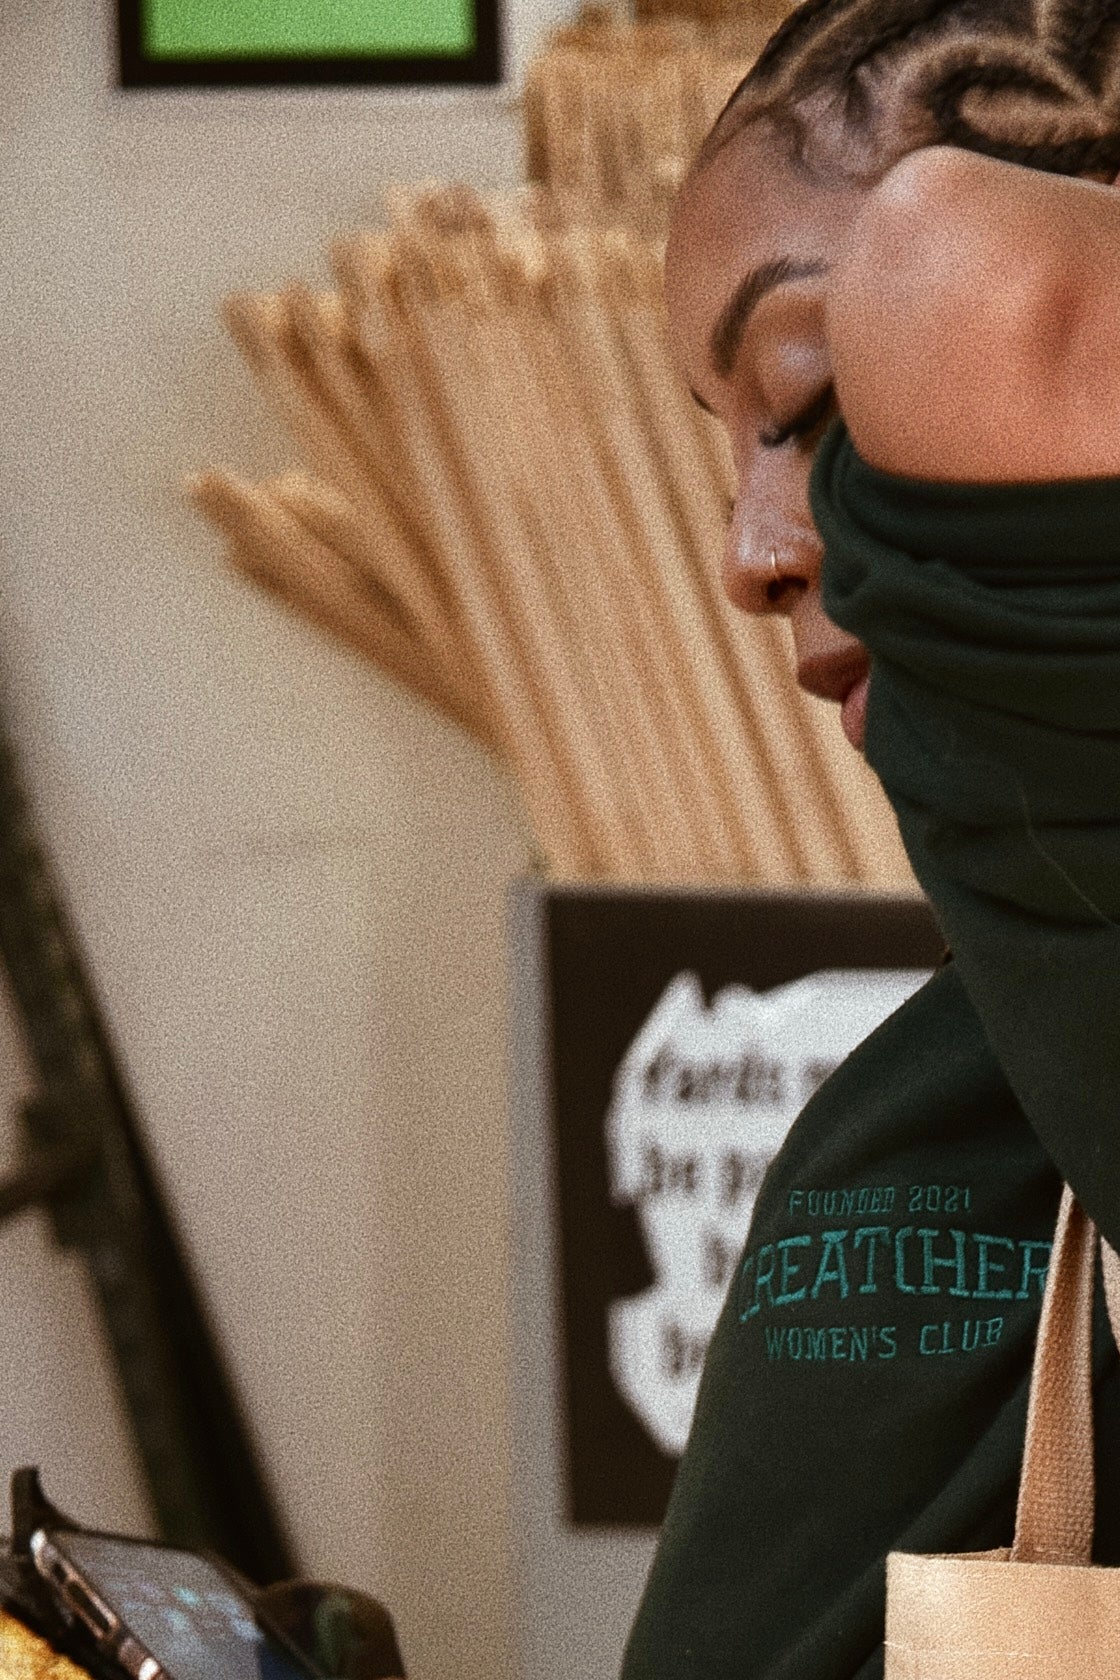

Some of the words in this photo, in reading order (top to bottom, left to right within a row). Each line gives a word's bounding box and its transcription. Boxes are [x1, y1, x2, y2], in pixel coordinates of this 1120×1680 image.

[788, 1185, 895, 1217] FOUNDED
[908, 1184, 971, 1213] 2021
[765, 1326, 897, 1361] WOMEN'S
[919, 1317, 1004, 1355] CLUB
